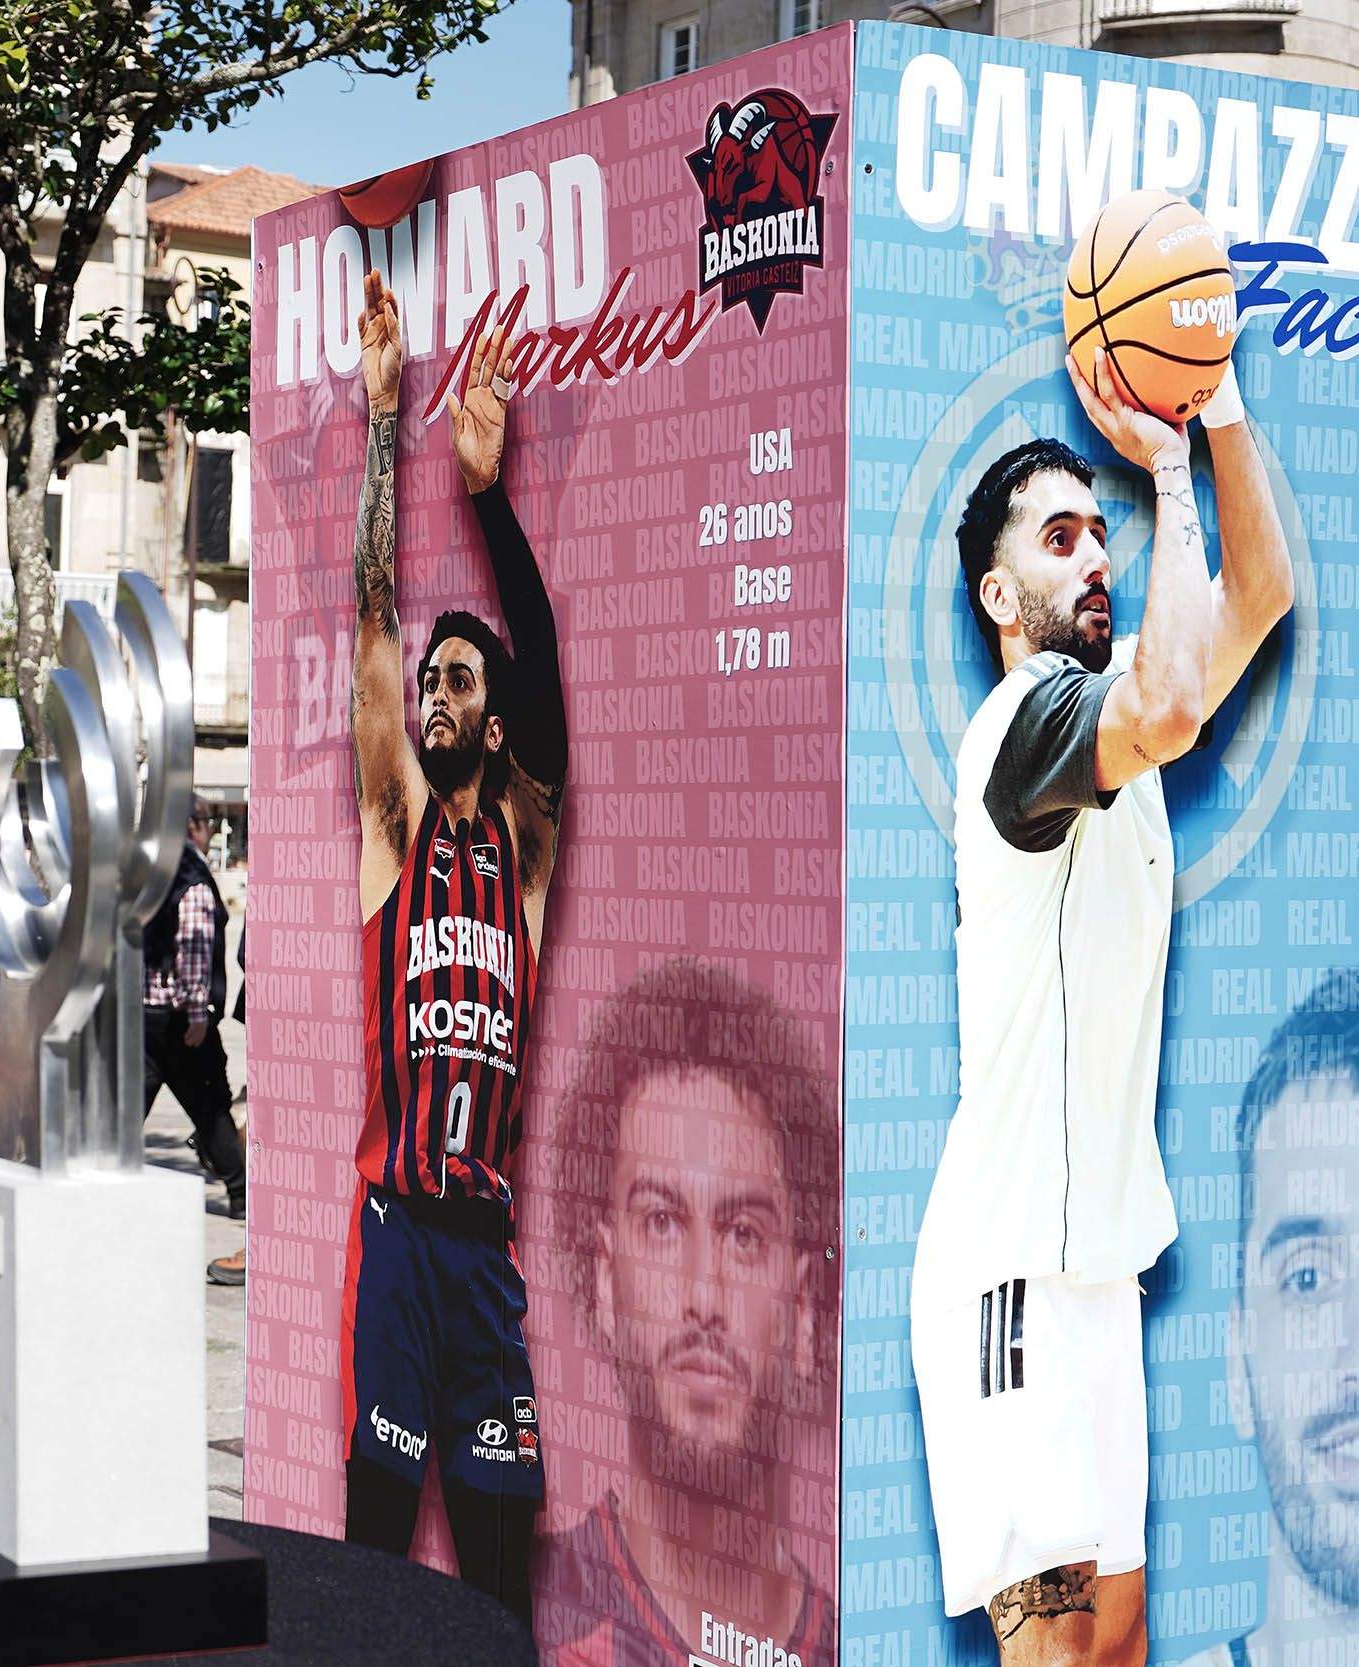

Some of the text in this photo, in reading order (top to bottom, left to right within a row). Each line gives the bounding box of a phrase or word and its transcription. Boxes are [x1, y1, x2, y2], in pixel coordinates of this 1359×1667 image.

[777, 32, 848, 105] BASK
[606, 143, 682, 210] SKONIA
[631, 192, 702, 257] BASK
[704, 205, 819, 282] BASKONIA
[276, 153, 608, 387] HOWARD
[727, 271, 761, 298] VITORIA
[858, 239, 969, 299] MADRID
[778, 271, 844, 331] BASK
[422, 266, 716, 421] Markus
[708, 328, 833, 401] BASKONIA
[857, 312, 929, 368] REAL
[938, 322, 1061, 382] MADRID
[516, 427, 613, 487] ASKONIA
[634, 402, 751, 468] BASKONIA
[777, 384, 844, 444] BASK
[749, 427, 793, 475] USA
[856, 387, 973, 445] MADRID
[1295, 424, 1359, 474] MAD
[856, 460, 926, 515] REAL
[251, 525, 316, 572] SKONIA
[574, 468, 686, 530] BASKONIA
[698, 505, 727, 547] 26
[734, 501, 792, 541] anos
[275, 565, 354, 613] BASKON
[401, 550, 487, 600] ASKONIA
[536, 532, 614, 585] SKONIA
[734, 565, 791, 606] Base
[855, 533, 1359, 609] MADRI MAD
[575, 576, 685, 632] BASKONIA
[854, 606, 923, 659] REAL
[566, 627, 715, 684] ONIA BASKO
[715, 630, 790, 677] 1,78 m
[576, 675, 829, 734] BASKONIA BASKONIA
[1289, 696, 1359, 744] MAD
[275, 732, 841, 789] BASKON ONIA BASKONIA BASK
[853, 754, 920, 806] REAL
[1288, 764, 1354, 811] REAL
[249, 789, 829, 840] SKONIA BASKONIA BASKONIA
[567, 844, 616, 889] ONIA
[636, 845, 751, 894] BASKONIA
[773, 847, 841, 898] BASK
[852, 828, 1359, 879] MADRI REAL MADR
[248, 884, 829, 955] SKONIA BASKONIA BASKONIA
[851, 899, 1352, 952] REAL ADRID REAL
[406, 915, 515, 998] BASKONIA
[541, 944, 616, 993] SKONIA
[638, 951, 750, 1006] BASKONIA
[772, 959, 840, 1015] BASK
[247, 970, 313, 1015] SKONIA
[576, 997, 686, 1053] BASKONIA
[851, 966, 1359, 1026] MADRI REAL MADR
[538, 1044, 615, 1097] SKONIA
[771, 1071, 837, 1129] BASK
[850, 1046, 919, 1100] REAL
[1287, 1033, 1350, 1082] REAL
[247, 1057, 315, 1105] SKONIA
[576, 1100, 685, 1161] BASKONIA
[445, 1081, 472, 1155] 0
[849, 1100, 1359, 1174] MADR REAL MADR
[249, 1143, 316, 1195] SKONIA
[524, 1142, 615, 1200] ASKONIA
[1288, 1167, 1352, 1217] REAL
[273, 1192, 349, 1247] BASKON
[248, 1230, 315, 1285] SKONIA
[848, 1265, 913, 1321] MAD
[1150, 1308, 1257, 1365] MADRID
[1285, 1300, 1348, 1353] REAL
[288, 1327, 764, 1512] BASK ASKONIA BASKONIA
[847, 1411, 916, 1468] MAD
[1283, 1367, 1359, 1421] MADR
[472, 1444, 516, 1463] HYUNDAI
[287, 1415, 337, 1473] BASK
[649, 1535, 763, 1623] BASKONIA
[847, 1484, 918, 1542] REAL
[1152, 1444, 1258, 1503] MADRID
[845, 1500, 1359, 1615] MADR REAL MADR
[1149, 1580, 1257, 1642] MADRID
